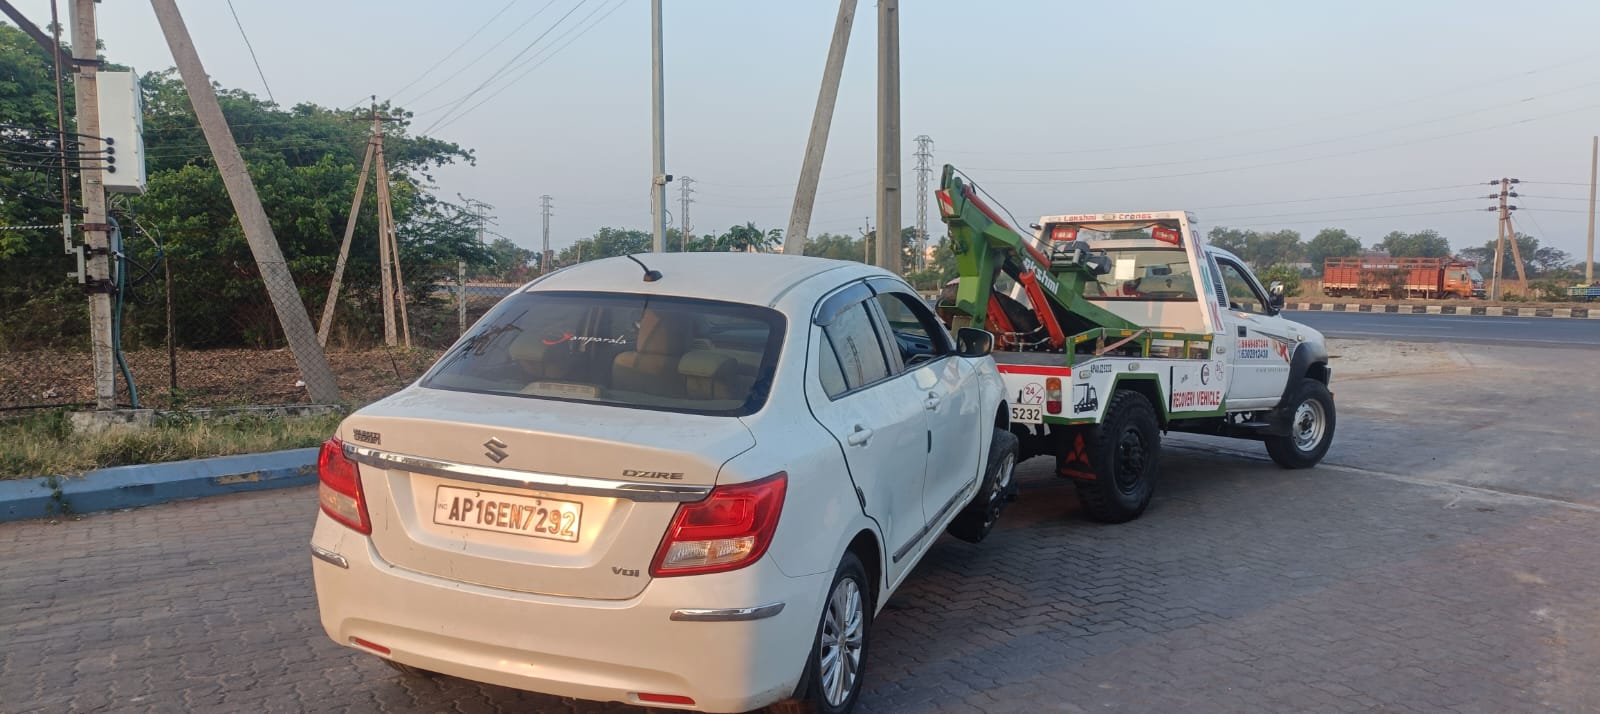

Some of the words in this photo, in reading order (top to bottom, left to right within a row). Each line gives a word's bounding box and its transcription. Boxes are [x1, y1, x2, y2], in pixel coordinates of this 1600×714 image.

[1173, 391, 1195, 408] RECOVERY
[1197, 390, 1220, 406] VEHICLE
[1012, 407, 1040, 421] 5232
[622, 469, 684, 480] DZIRE
[448, 496, 576, 537] AP16EN7292
